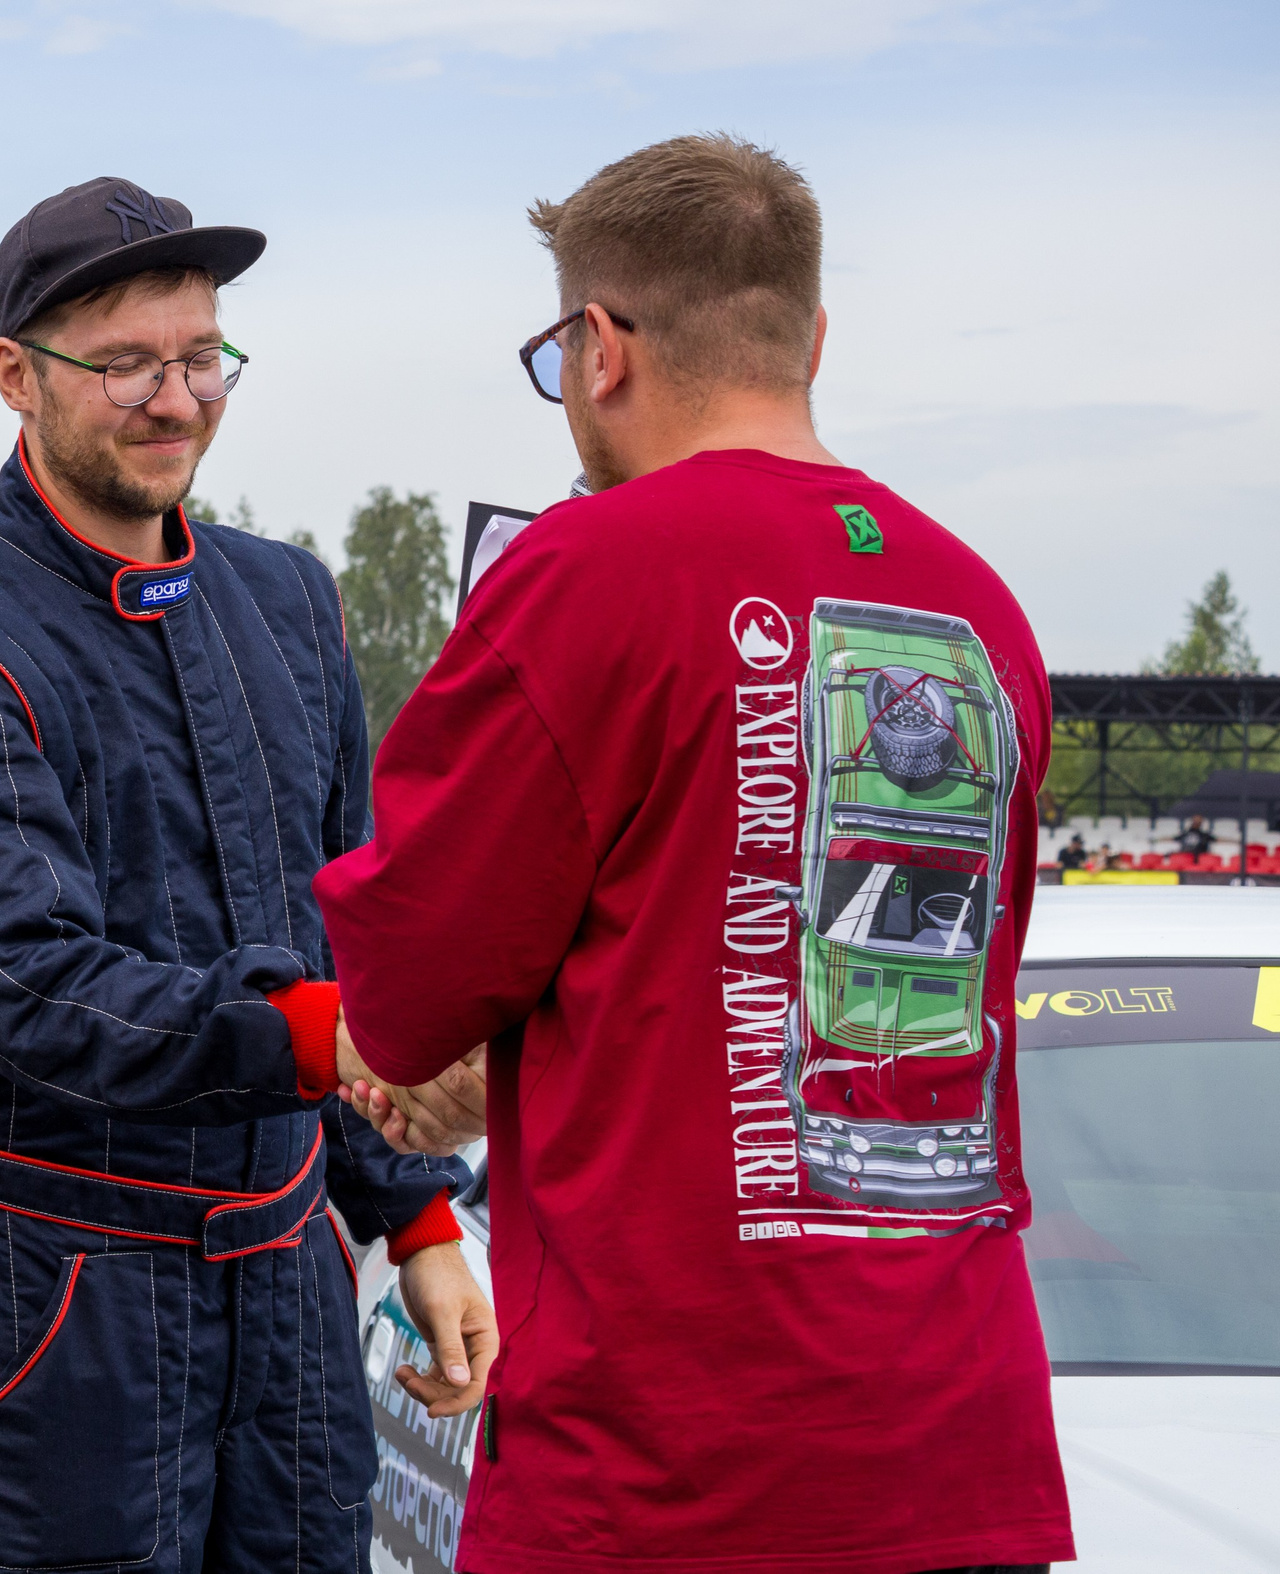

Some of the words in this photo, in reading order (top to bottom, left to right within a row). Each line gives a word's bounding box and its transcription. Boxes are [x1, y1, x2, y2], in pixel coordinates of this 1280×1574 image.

[735, 680, 798, 856] EXPLORE
[723, 869, 790, 954] AND
[722, 965, 799, 1199] ADVENTURE
